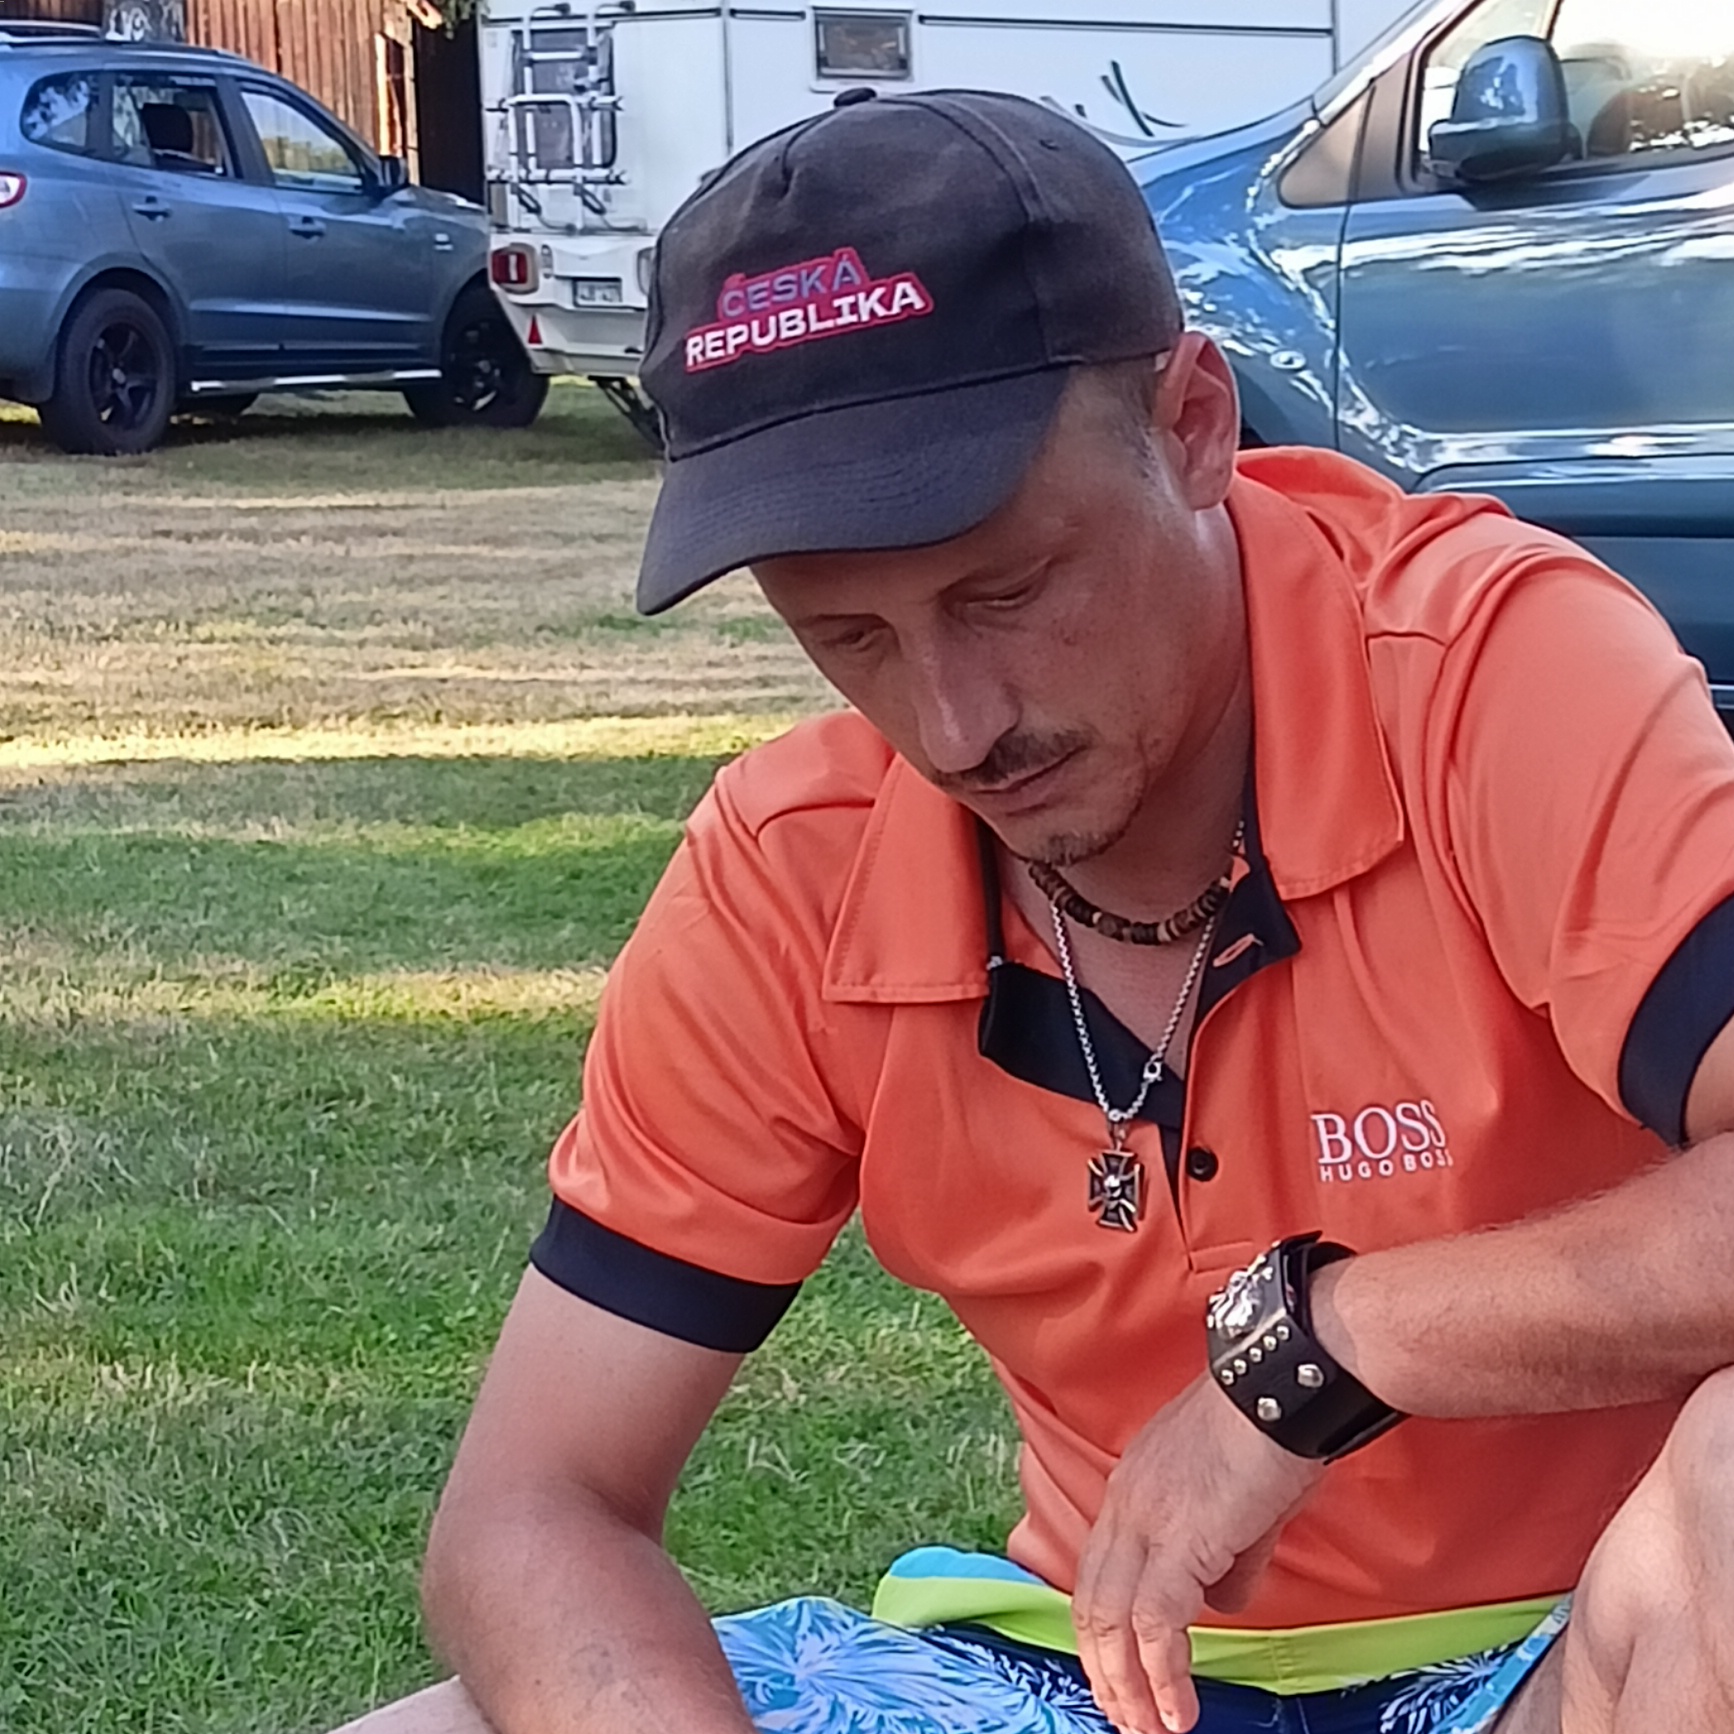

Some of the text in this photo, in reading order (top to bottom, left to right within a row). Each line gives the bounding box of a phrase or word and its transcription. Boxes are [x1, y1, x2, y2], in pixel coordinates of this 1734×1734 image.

[685, 281, 926, 367] REPUBLIKA
[1310, 1099, 1446, 1164] BOSS
[1319, 1160, 1394, 1182] HUGO
